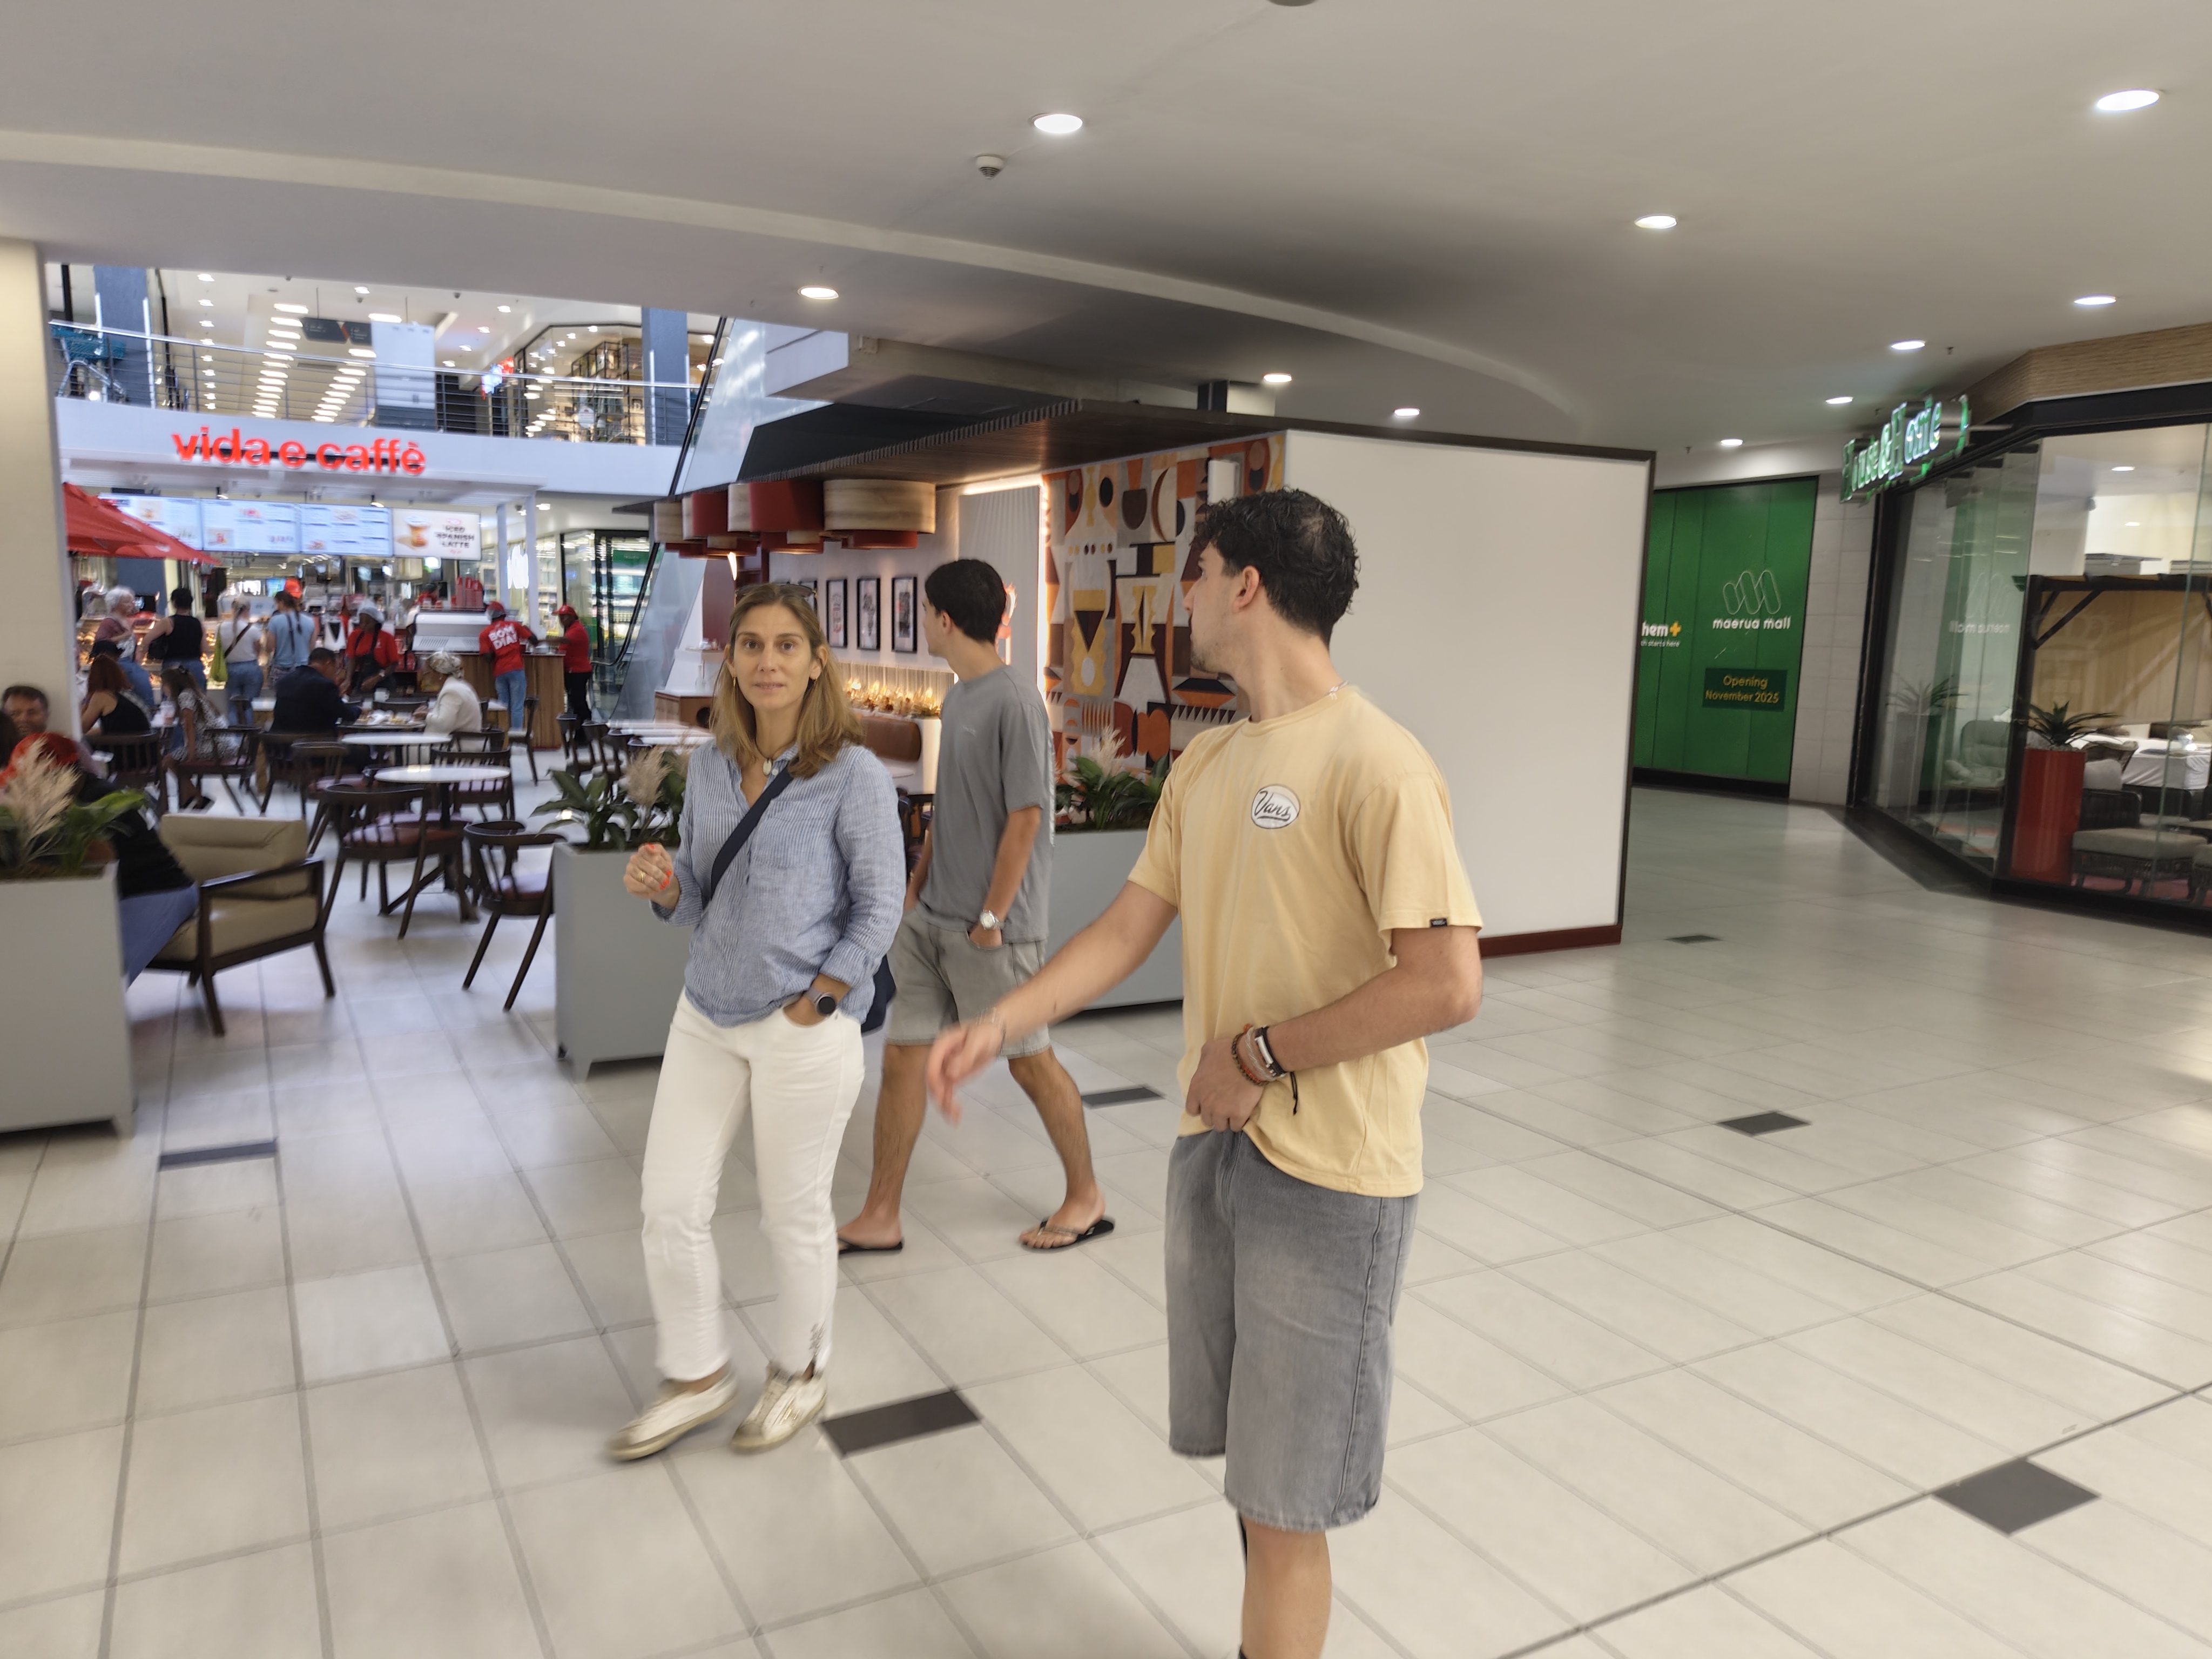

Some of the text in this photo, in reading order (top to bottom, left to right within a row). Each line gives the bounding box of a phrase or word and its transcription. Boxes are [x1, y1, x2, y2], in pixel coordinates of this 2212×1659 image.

[172, 425, 426, 476] vida e caffè
[1712, 615, 1791, 630] maerua mall
[488, 625, 516, 642] BOM
[493, 633, 518, 650] DIA!
[1666, 639, 1681, 648] here
[1723, 675, 1768, 690] Opening
[1705, 689, 1779, 704] November 2025
[1254, 790, 1291, 822] Vans
